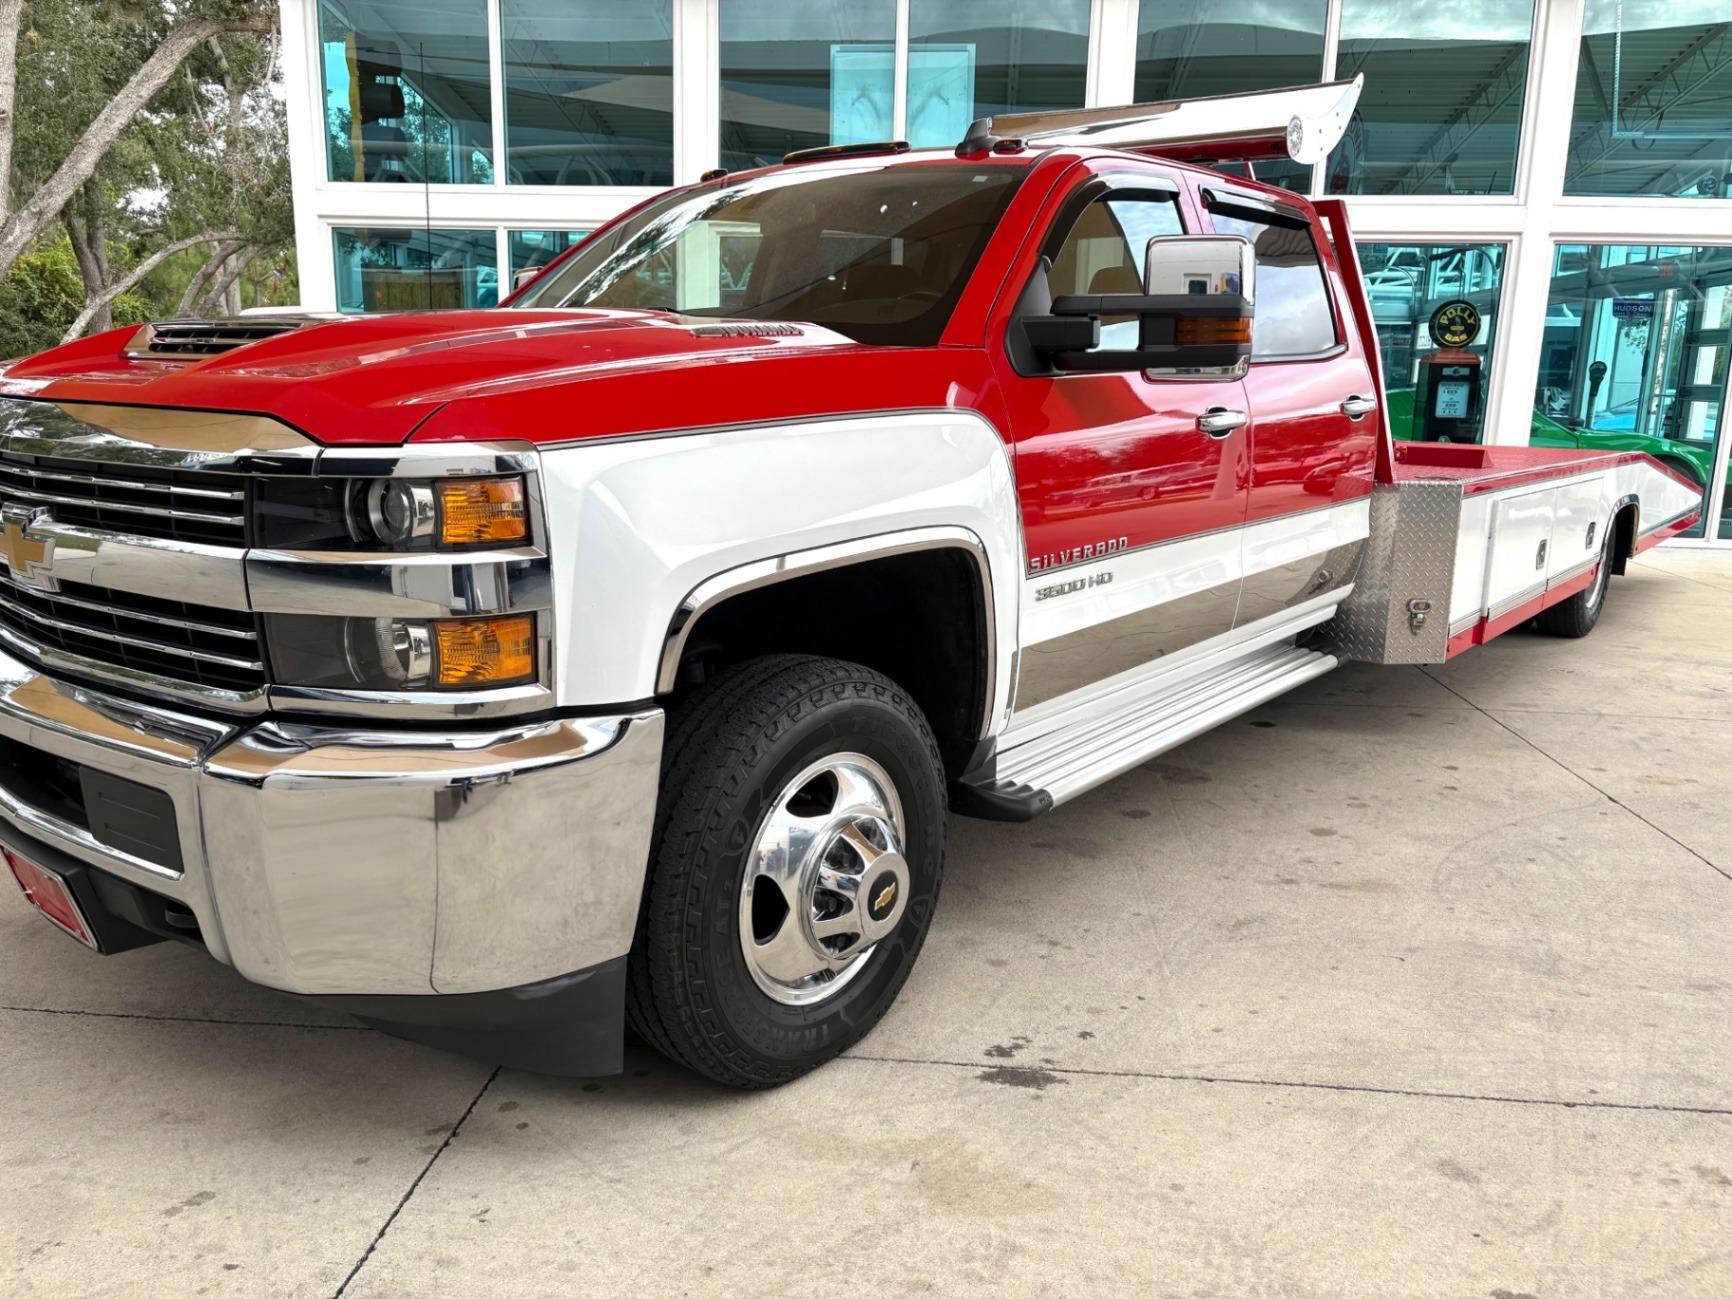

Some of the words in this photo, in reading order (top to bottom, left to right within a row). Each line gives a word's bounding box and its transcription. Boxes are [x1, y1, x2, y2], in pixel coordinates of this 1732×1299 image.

[1439, 307, 1476, 325] POLLY
[1614, 305, 1652, 313] HUDSON
[1444, 332, 1468, 343] GAS
[1029, 536, 1128, 570] SILVERADO
[1035, 577, 1086, 602] 3500
[1088, 571, 1114, 588] HD
